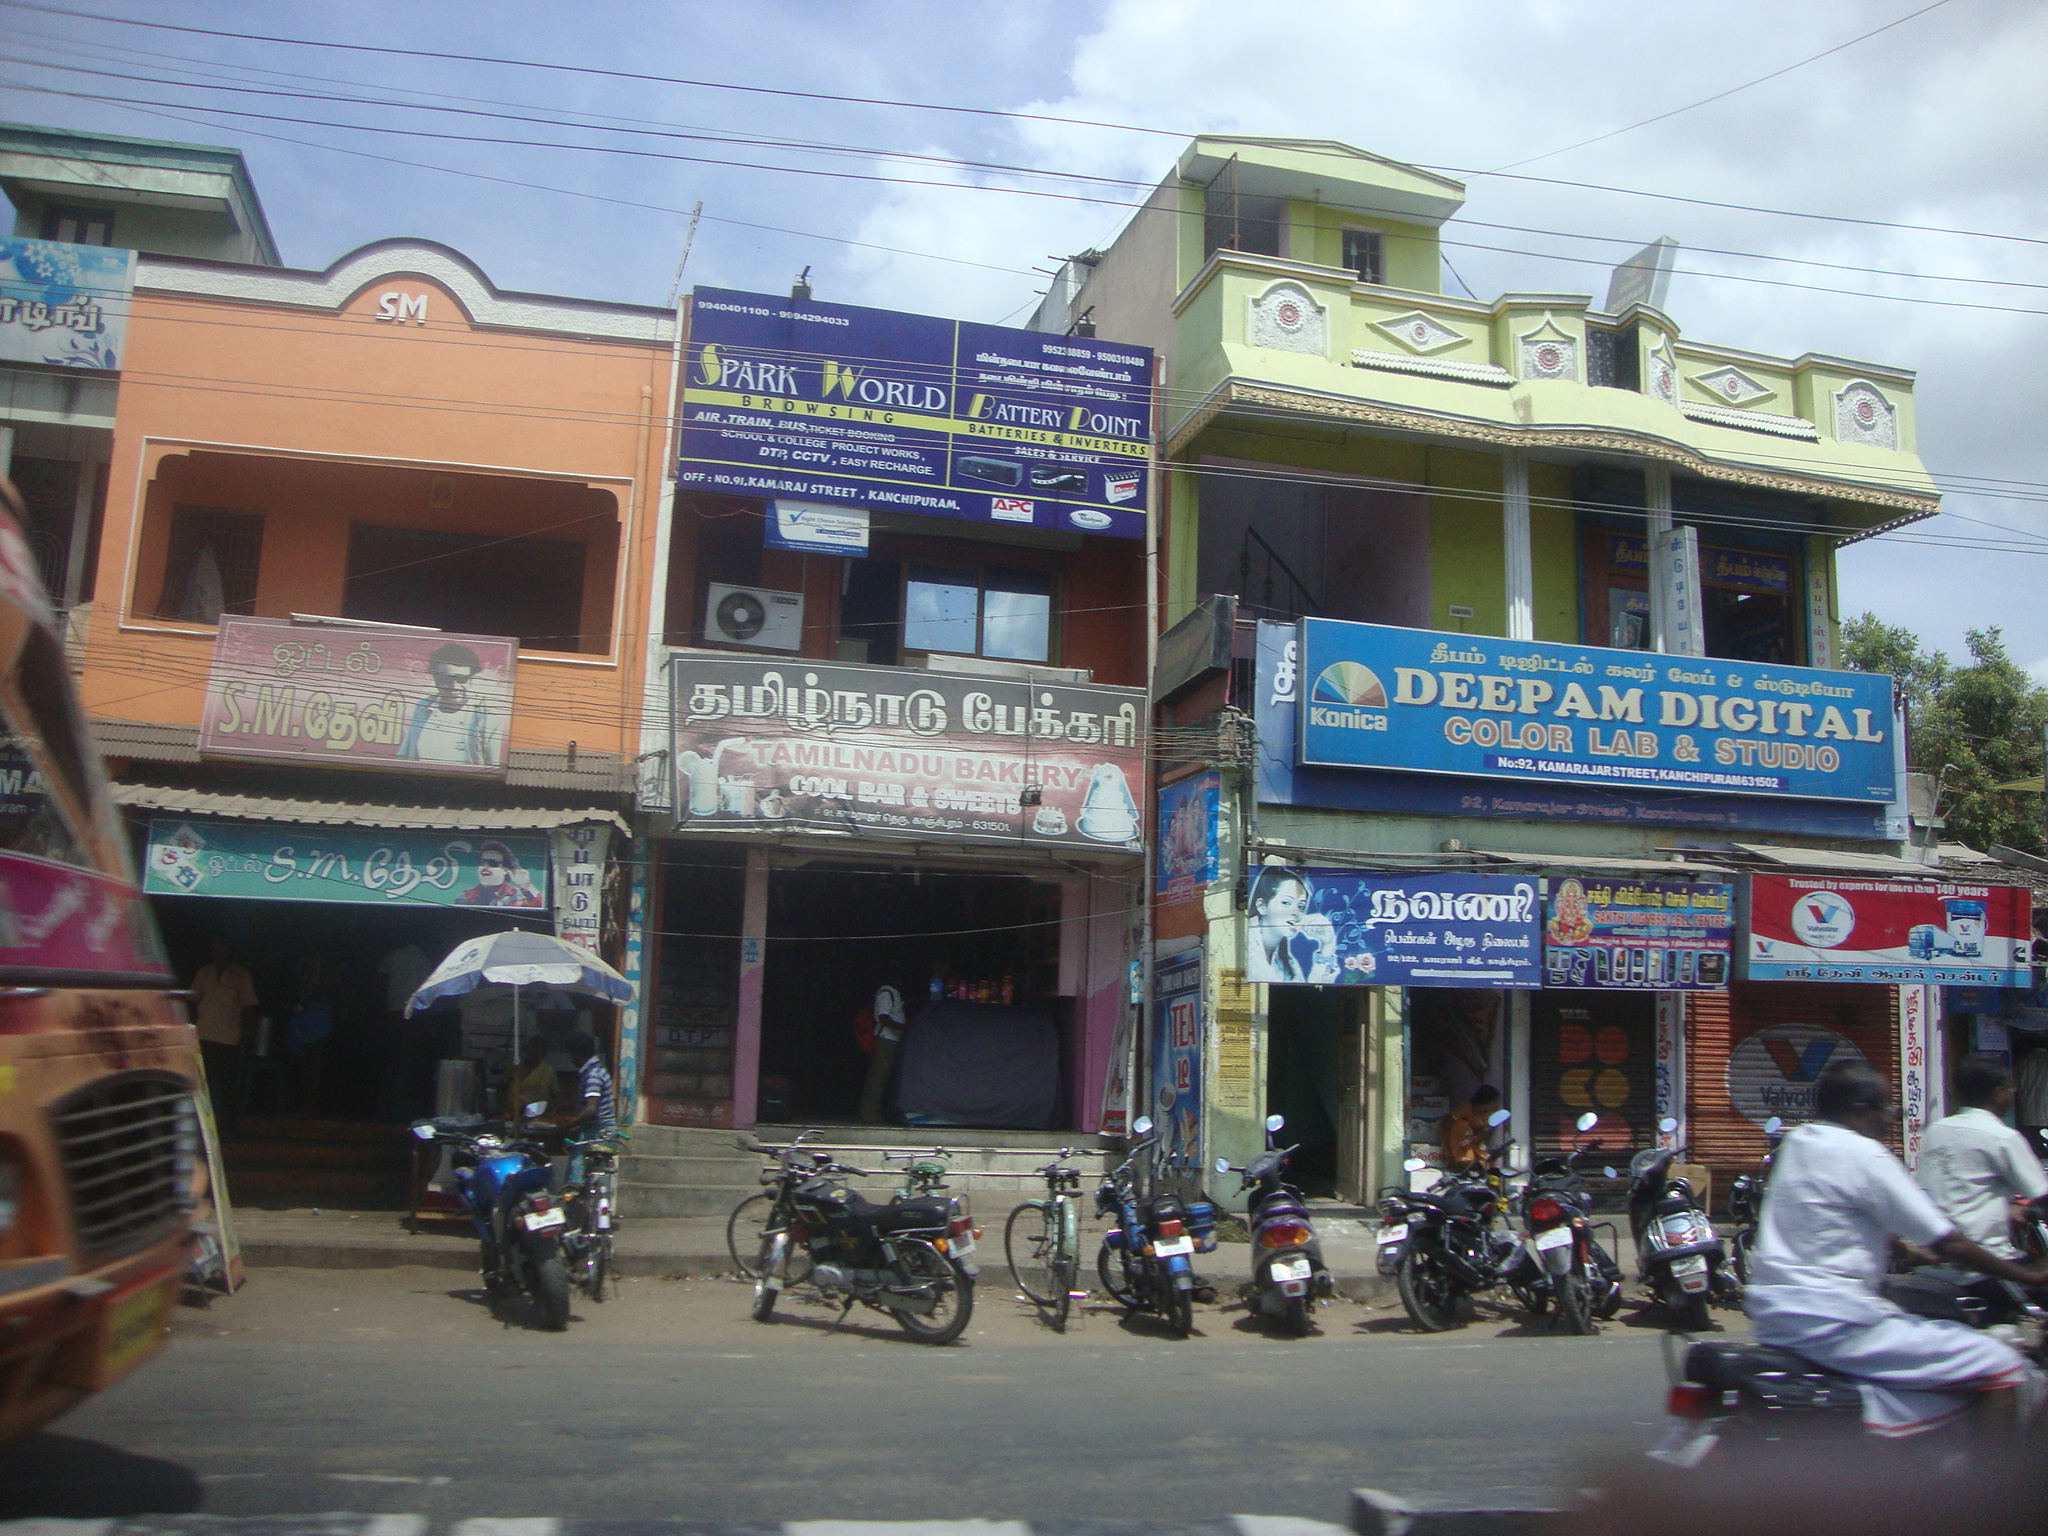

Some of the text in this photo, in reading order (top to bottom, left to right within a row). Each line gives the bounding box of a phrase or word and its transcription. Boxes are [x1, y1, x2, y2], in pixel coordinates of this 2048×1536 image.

[376, 291, 427, 323] SM
[697, 300, 770, 316] 9940401100
[779, 310, 850, 326] 9994294033
[693, 343, 946, 411] SPARK WORLD
[742, 395, 895, 424] BROWSING
[967, 393, 1141, 437] BATTERY POINT
[694, 411, 719, 423] AIR
[847, 427, 896, 443] BOOKING
[721, 429, 766, 443] SCHOOL
[766, 434, 776, 443] &
[777, 435, 828, 449] COLLEGE
[831, 441, 881, 454] PROJECT
[969, 423, 1146, 456] BATTERIES & INVERTERS
[840, 456, 868, 468] EASY
[1014, 446, 1045, 458] SALES
[1059, 452, 1101, 464] SERVICE
[809, 483, 858, 498] STREET
[993, 498, 1032, 513] APC
[1429, 643, 1487, 666] தீபம்
[1605, 660, 1657, 684] கலர்
[1668, 666, 1717, 687] லேப்
[1728, 673, 1743, 688] &
[685, 671, 1137, 748] தமிழ்நாடு பேக்கரி
[1309, 705, 1388, 732] Konica
[1393, 667, 1885, 744] DEEPAM DIGITAL
[1444, 716, 1841, 773] COLOR LAB & STUDIO
[751, 742, 1083, 789] TAMILNADU BAKERY
[789, 775, 1022, 815] COOL BAR & SWEETS
[1789, 879, 1989, 897] Trusted by experts for more than 140 years
[1593, 910, 1727, 928] SAKTHI VIGNESH CELL CENTRE
[1384, 929, 1437, 945] பெண்கள்
[1817, 966, 1863, 979] தேவி
[1868, 967, 1928, 981] ஆயில்
[1934, 970, 1999, 983] சென்டர்
[1170, 1002, 1196, 1048] TEA
